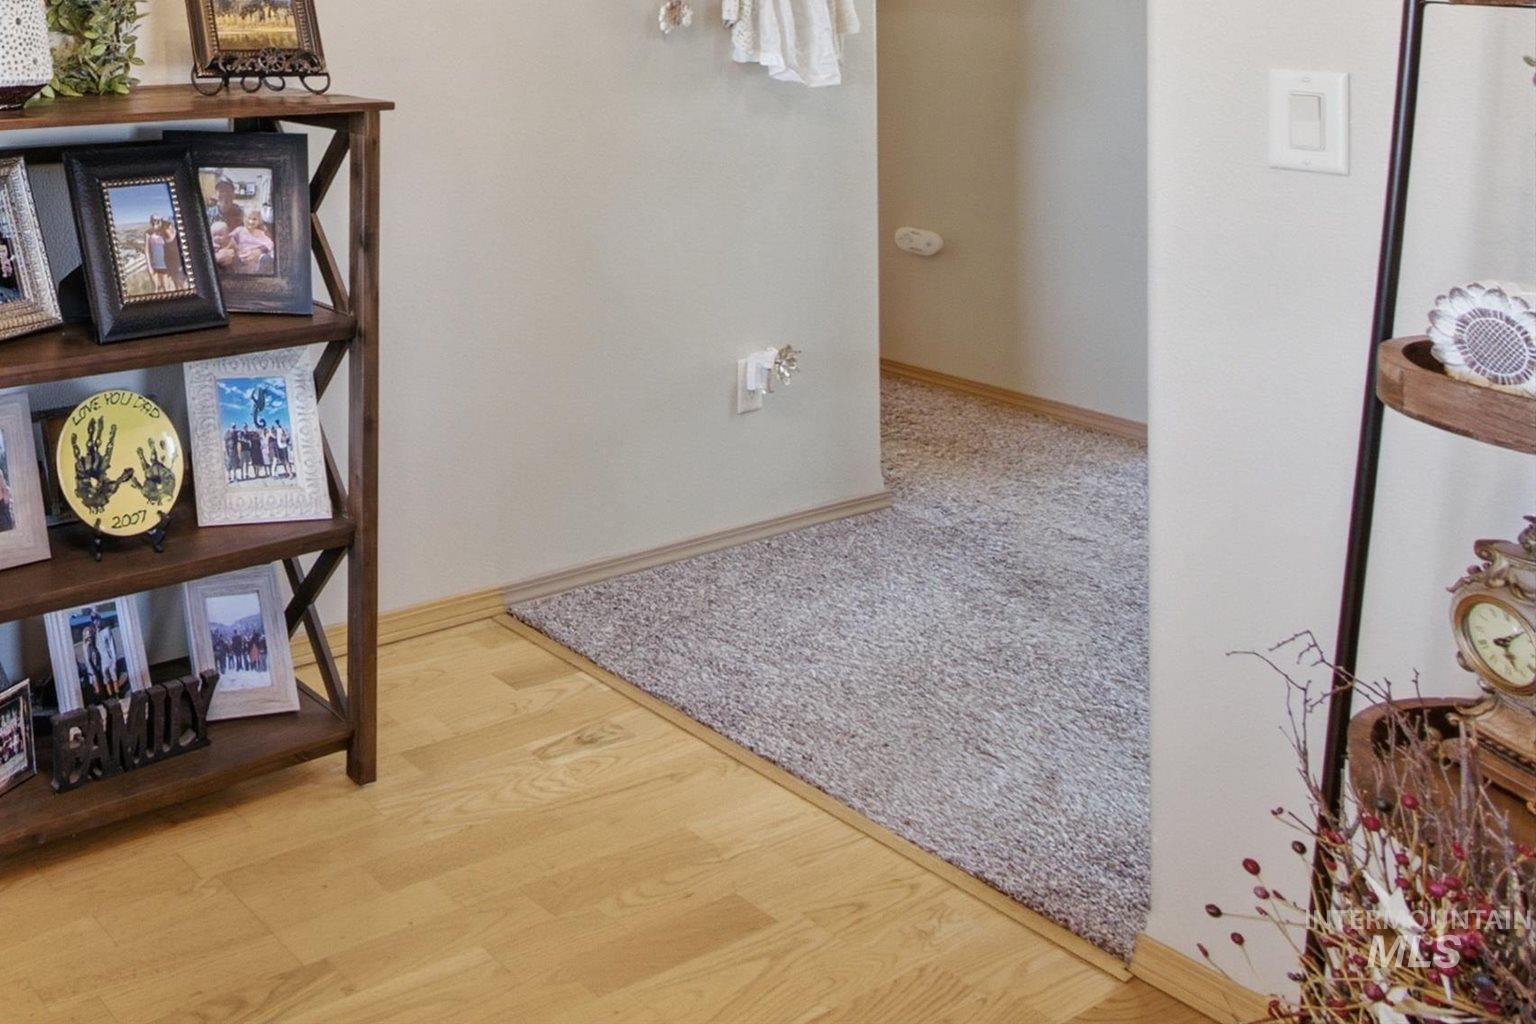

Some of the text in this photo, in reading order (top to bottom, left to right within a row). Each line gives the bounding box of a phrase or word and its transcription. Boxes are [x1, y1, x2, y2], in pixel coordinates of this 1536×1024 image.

[71, 392, 161, 426] LOVE YOU DAD
[111, 509, 147, 529] 2007
[50, 668, 220, 792] FAMILY
